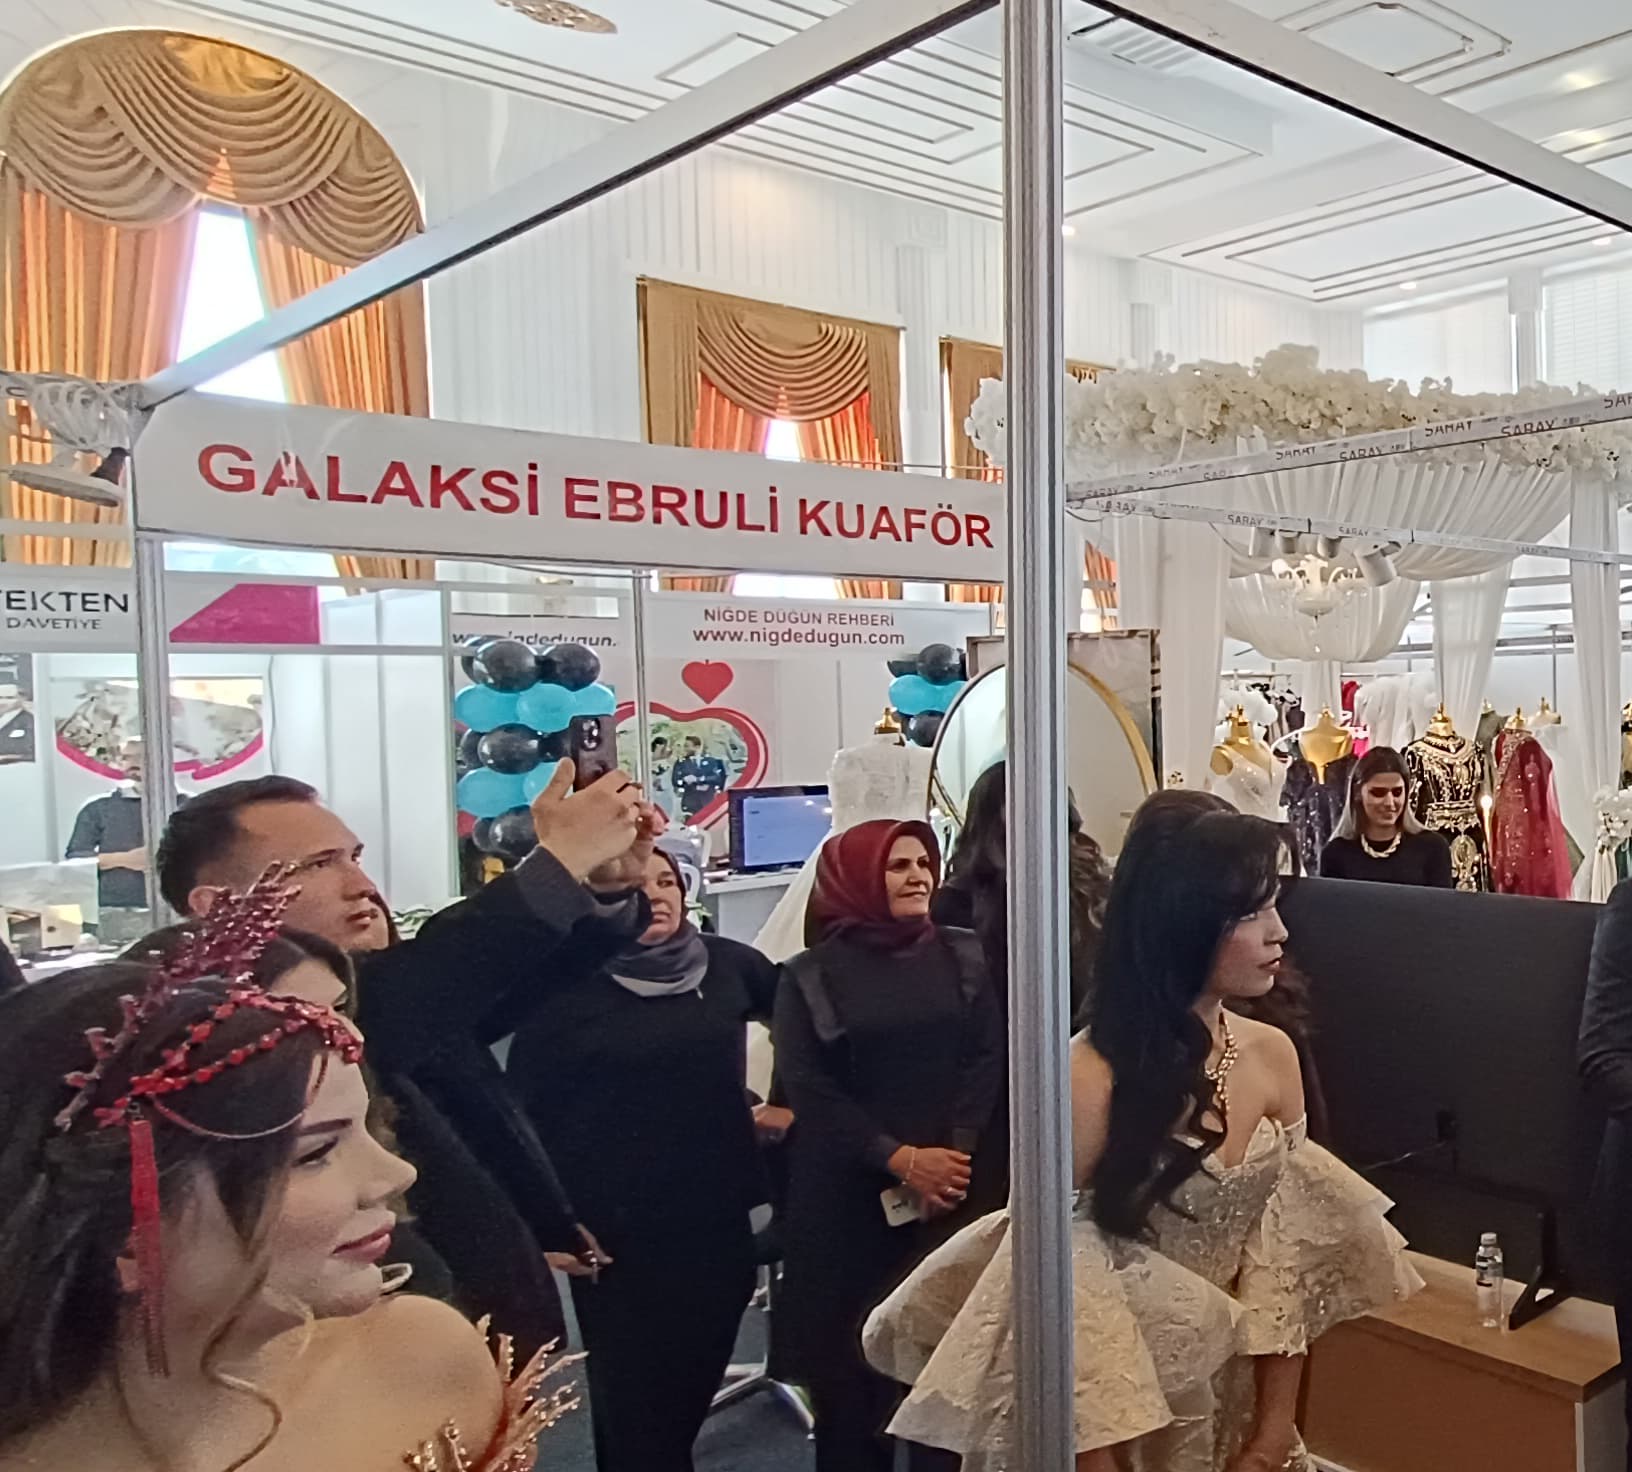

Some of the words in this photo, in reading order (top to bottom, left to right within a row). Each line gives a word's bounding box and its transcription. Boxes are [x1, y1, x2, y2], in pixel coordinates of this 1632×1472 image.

[198, 443, 539, 516] GALAKSİ
[564, 477, 780, 533] EBRULİ
[798, 498, 995, 548] KUAFÖR
[0, 589, 128, 613] EKTEN
[693, 628, 905, 648] www.nigdedugun.com
